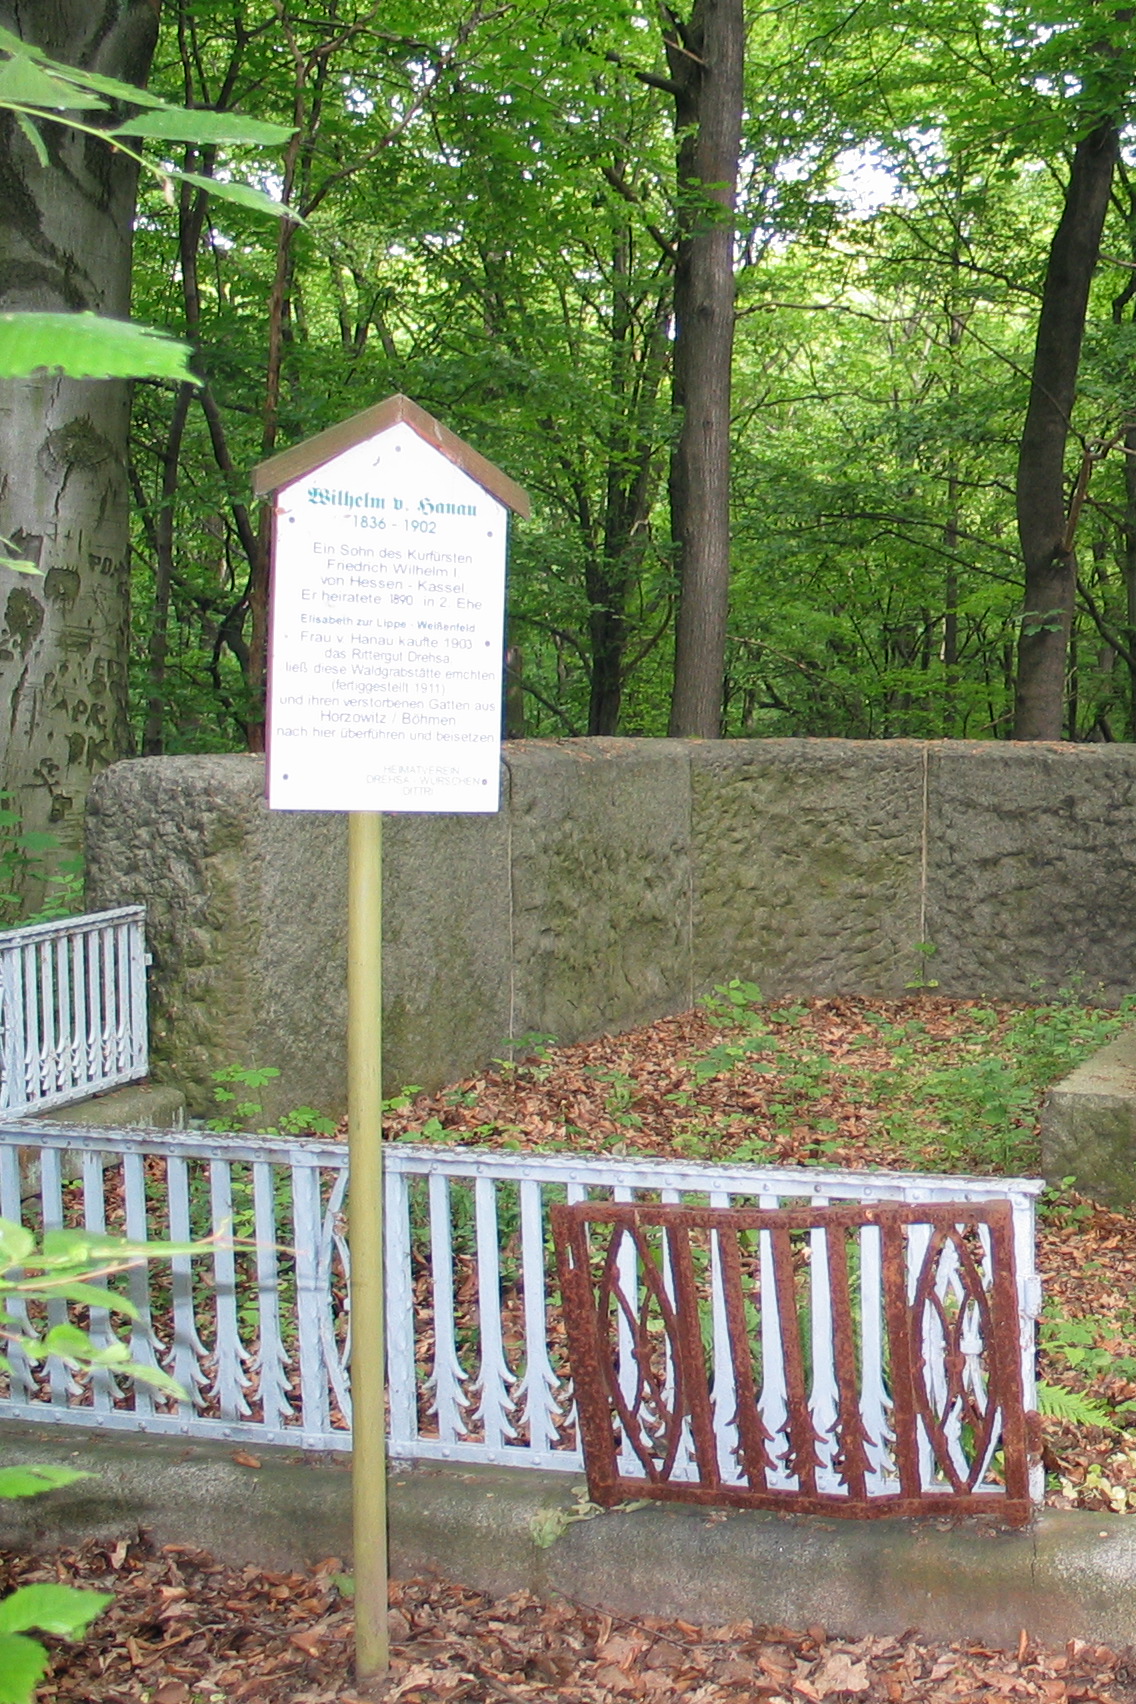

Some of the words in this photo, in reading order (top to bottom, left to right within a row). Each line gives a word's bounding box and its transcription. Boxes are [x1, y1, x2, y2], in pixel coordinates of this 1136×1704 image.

[306, 486, 386, 511] Wilhelm
[416, 497, 478, 517] Hanau
[352, 514, 387, 530] 1836
[404, 519, 438, 534] 1902
[312, 541, 336, 555] Ein
[339, 543, 375, 558] Sohn
[378, 547, 403, 560] des
[407, 548, 473, 565] Kurfürsten
[326, 558, 388, 574] Friedrich
[392, 563, 449, 578] Wilhelm
[320, 575, 345, 586] von
[349, 575, 404, 590] Hessen
[300, 588, 318, 601] Er
[321, 590, 383, 605] heiratete
[389, 593, 414, 606] 1890
[423, 595, 435, 607] in
[455, 597, 483, 611] Ehe
[300, 613, 354, 626] Elisabeth
[355, 618, 373, 627] zur
[376, 617, 407, 630] Lippe
[416, 620, 476, 633] Weißenfeld
[300, 630, 332, 644] Frau
[350, 634, 394, 647] Hanau
[397, 635, 439, 648] kaufte
[324, 647, 347, 660] das
[351, 647, 403, 664] Rittergut
[285, 661, 308, 674] ließ
[313, 663, 347, 676] diese
[351, 663, 441, 681] Waldgrabstätte
[414, 682, 446, 697] 1911)
[279, 694, 304, 706] und
[307, 695, 340, 707] ihren
[343, 696, 425, 710] verstorbenen
[428, 698, 470, 712] Gatten
[473, 701, 497, 712] aus
[319, 709, 387, 725] Horzowitz
[401, 711, 457, 727] Böhmen
[275, 726, 308, 738] nach
[311, 727, 337, 739] hier
[340, 727, 406, 742] überführen
[409, 729, 432, 742] und
